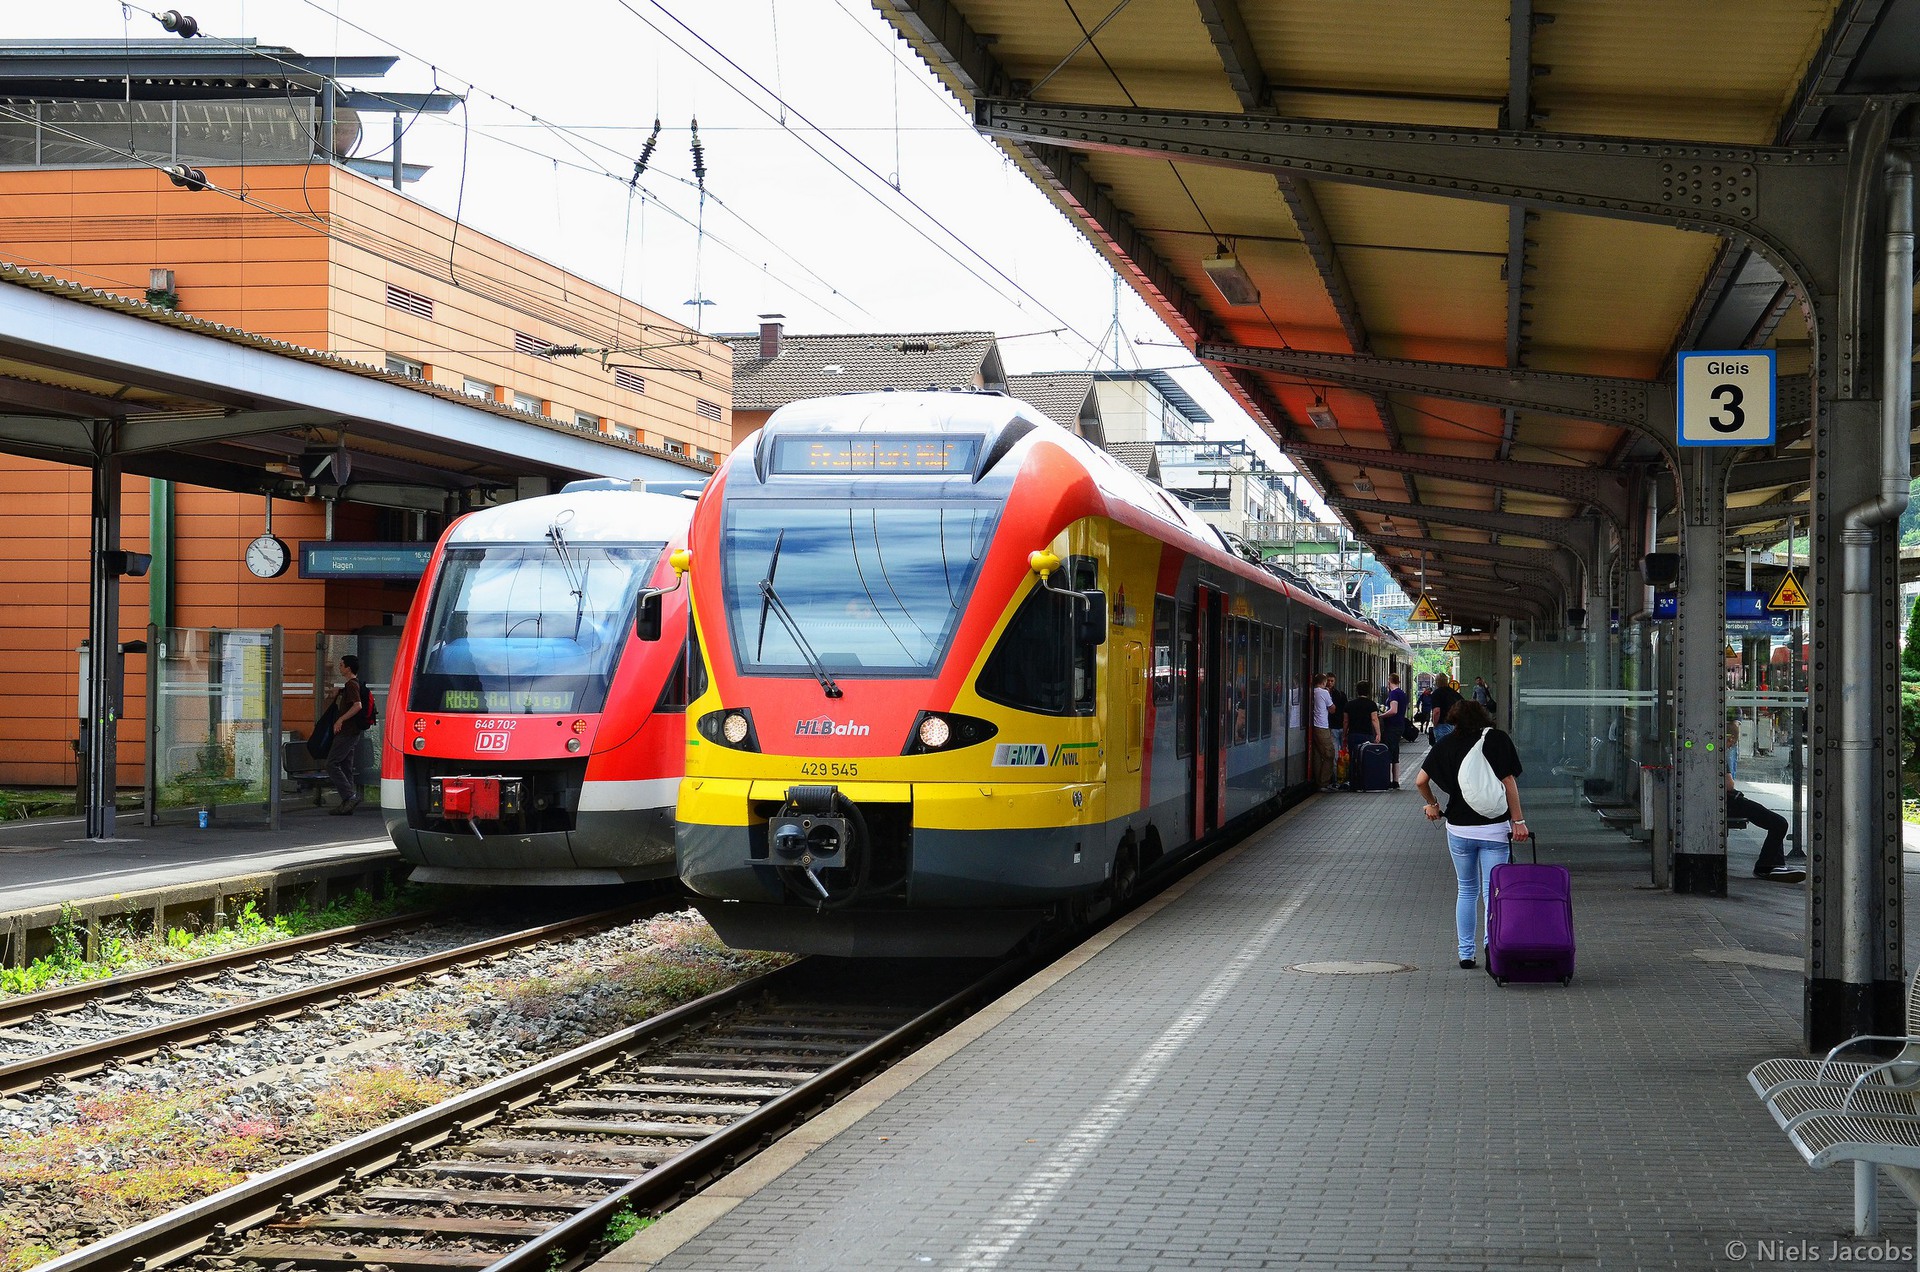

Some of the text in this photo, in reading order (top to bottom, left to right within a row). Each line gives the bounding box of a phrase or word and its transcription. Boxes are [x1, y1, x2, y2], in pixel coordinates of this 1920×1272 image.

[1707, 361, 1749, 375] Gleis
[1708, 383, 1746, 433] 3
[309, 552, 316, 565] 1
[332, 561, 354, 570] Hagen
[1755, 599, 1762, 610] 4
[445, 690, 479, 709] RB95
[474, 719, 517, 730] 648 702
[480, 734, 506, 749] DB
[1062, 752, 1079, 766] NWL
[801, 762, 858, 776] 429 545
